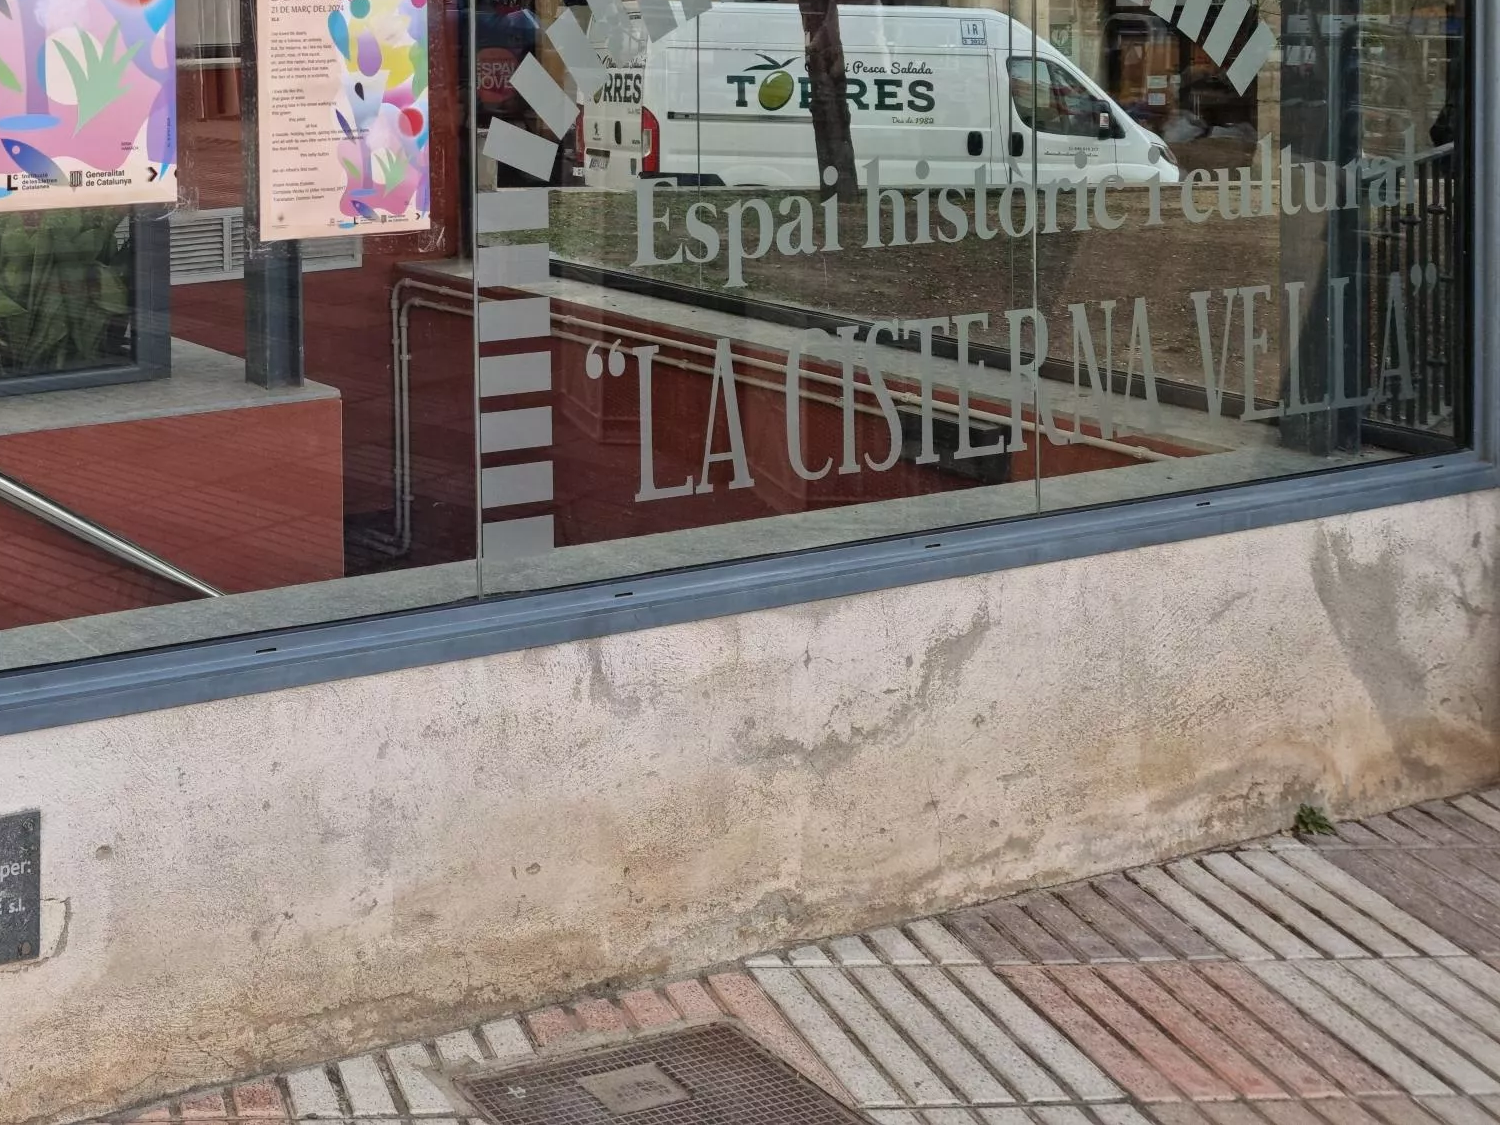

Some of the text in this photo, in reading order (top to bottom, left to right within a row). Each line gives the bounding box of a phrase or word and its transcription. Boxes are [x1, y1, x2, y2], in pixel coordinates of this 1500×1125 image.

[853, 61, 886, 74] Pesca
[891, 62, 933, 74] Salada
[594, 73, 642, 104] RRES
[86, 170, 125, 178] Generalitat
[97, 177, 132, 186] Catalunya
[630, 123, 1416, 288] Espai històric i cultural
[785, 297, 1161, 481] CISTERNA
[0, 859, 32, 881] per:
[9, 899, 25, 913] s.l.
